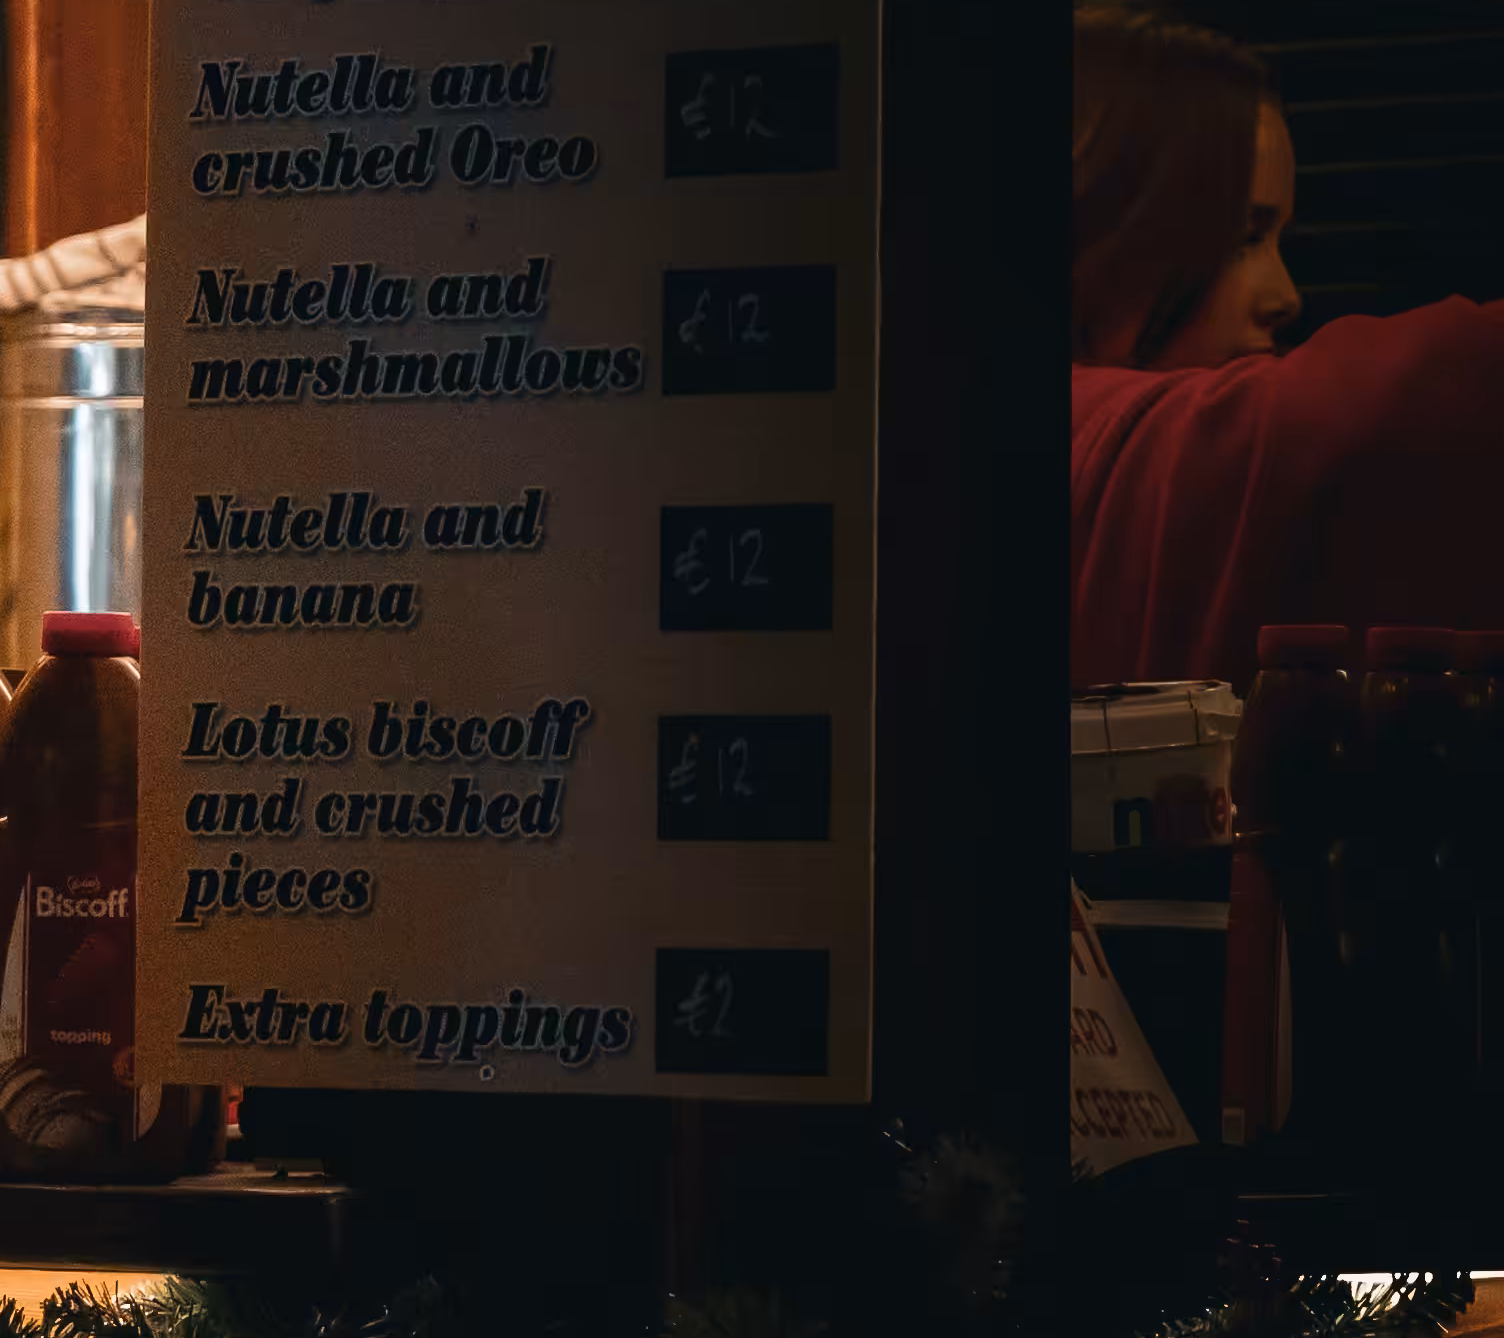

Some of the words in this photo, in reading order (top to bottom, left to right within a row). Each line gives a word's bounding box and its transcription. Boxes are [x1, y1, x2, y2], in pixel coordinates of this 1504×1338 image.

[190, 54, 413, 120] Nutella
[430, 43, 552, 110] and
[192, 131, 436, 194] crushed
[450, 124, 598, 187] Oreo
[188, 265, 411, 328] Nutella
[427, 259, 551, 321] and
[188, 335, 645, 402] marshmallows
[185, 493, 408, 552] Nutella
[424, 489, 545, 552] and
[190, 572, 417, 630] banana
[183, 704, 352, 760] Lotus
[368, 700, 591, 760] biscoff
[185, 780, 301, 836] and
[314, 777, 563, 836] crushed
[36, 885, 129, 919] Biscoff
[174, 855, 373, 926] pieces
[179, 985, 348, 1043] Extra
[362, 990, 633, 1064] toppings
